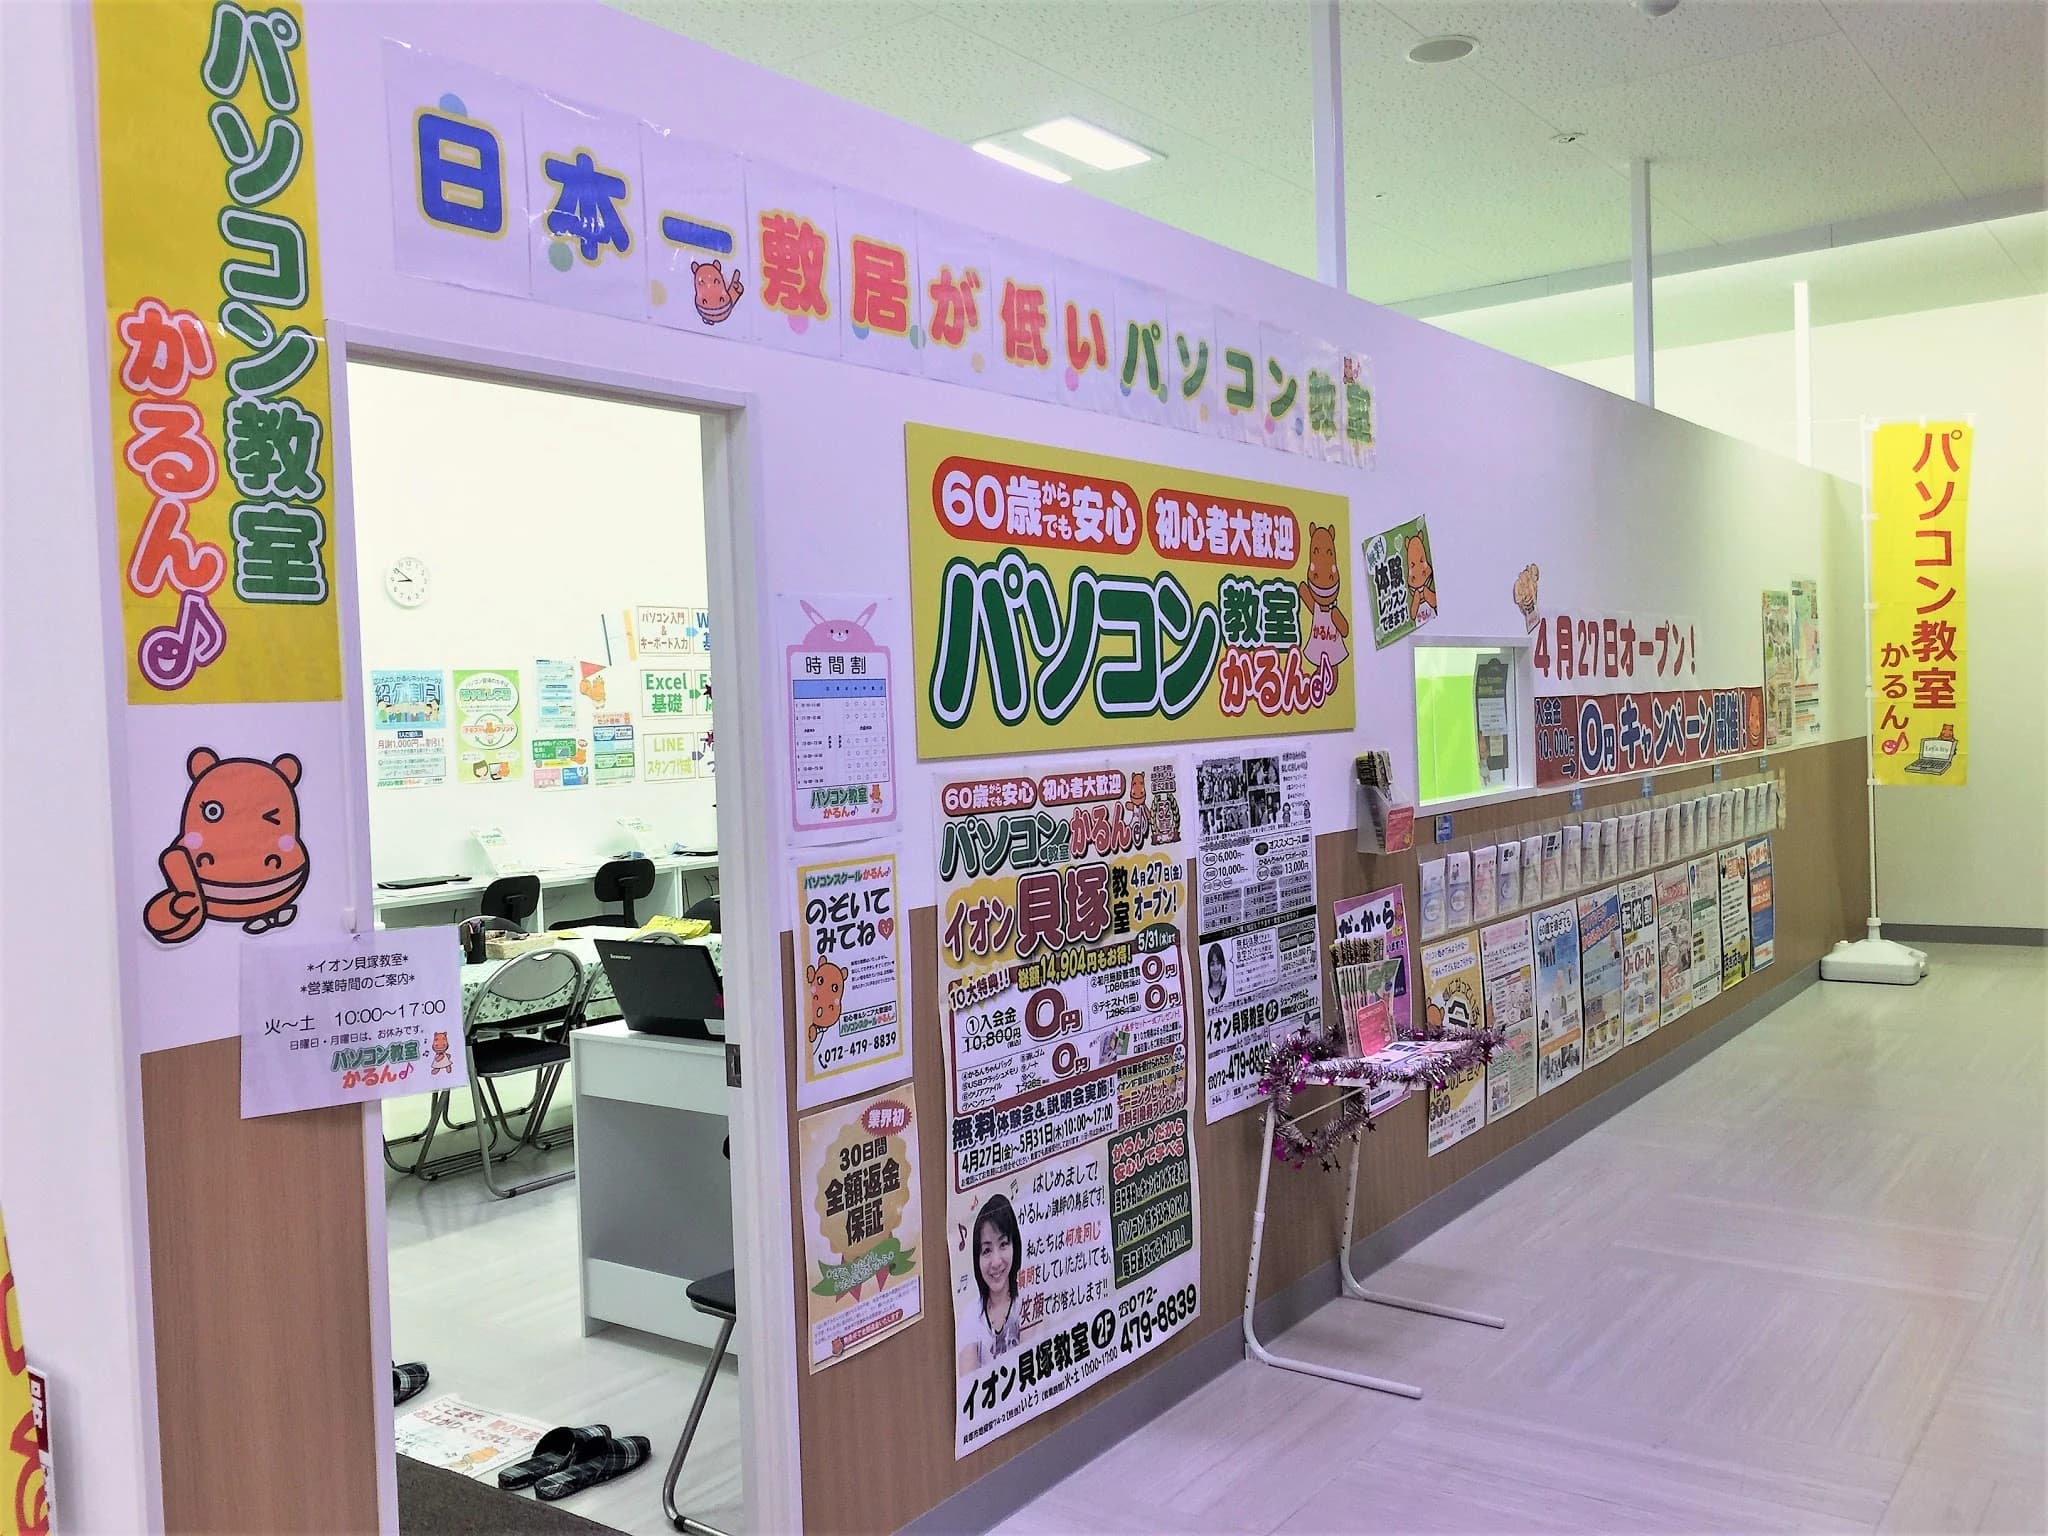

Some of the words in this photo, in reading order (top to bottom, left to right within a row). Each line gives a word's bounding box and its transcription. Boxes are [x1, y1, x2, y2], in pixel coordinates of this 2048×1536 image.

[200, 0, 329, 605] パソコン教室
[117, 296, 227, 598] かるん
[1154, 496, 1295, 562] 初心者大歓迎
[1374, 554, 1405, 597] 体験
[1911, 429, 1963, 710] パソコン教室
[641, 611, 686, 625] パソコン入門
[1378, 588, 1408, 617] レッスン
[640, 637, 689, 650] キーボード入力
[1534, 615, 1696, 680] 4月27日オープン!
[645, 673, 688, 690] Excel
[805, 655, 867, 675] 時間割
[1218, 646, 1311, 718] かるん
[1880, 642, 1909, 730] かるん
[651, 694, 683, 713] 基礎
[653, 737, 686, 752] LINE
[810, 785, 869, 809] パソコン教室
[1042, 773, 1124, 801] 初心者大歓迎
[823, 806, 851, 819] かるん
[1069, 802, 1132, 857] かるん
[805, 888, 891, 925] のぞいて
[1134, 887, 1178, 921] オープン!
[816, 921, 877, 955] みてね
[1142, 955, 1178, 983] 0円
[334, 999, 446, 1027] 10:00〜17:00
[1024, 986, 1084, 1043] 0円
[1144, 983, 1183, 1013] 0円
[1206, 1003, 1265, 1045] イオン貝塚教室
[330, 1040, 421, 1072] パソコン教室
[825, 1031, 897, 1063] 072-479-8839
[1052, 1043, 1090, 1079] 0円
[342, 1064, 397, 1089] かるん
[868, 1107, 905, 1130] 業界初
[838, 1136, 888, 1172] 30日間
[824, 1158, 901, 1217] 全額返金
[1032, 1160, 1099, 1194] はじめまして!
[845, 1197, 884, 1247] 保証
[962, 1320, 1092, 1422] イオン貝塚教室
[1120, 1283, 1197, 1355] 479-8839
